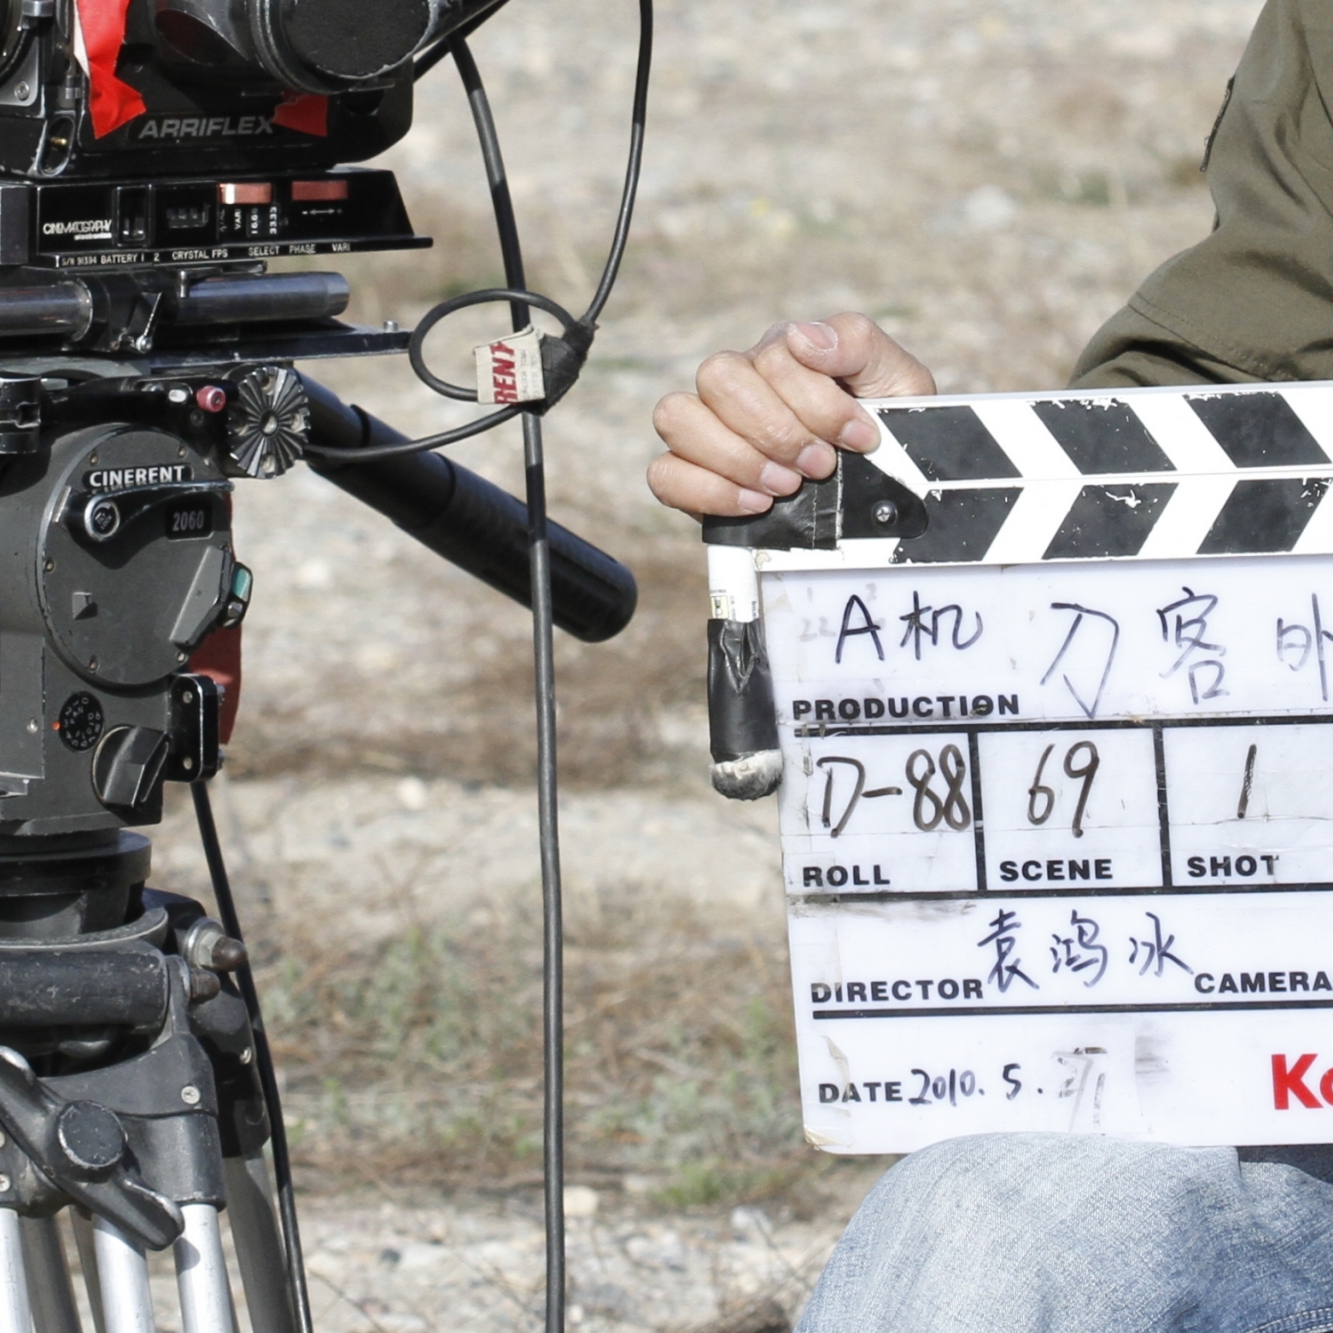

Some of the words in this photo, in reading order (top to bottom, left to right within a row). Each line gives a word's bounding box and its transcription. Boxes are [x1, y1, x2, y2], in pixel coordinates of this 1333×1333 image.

[139, 115, 274, 140] ARRIFLEX
[100, 254, 137, 265] BATTERY
[153, 252, 160, 262] 2
[172, 250, 209, 260] CRYSTAL
[212, 249, 228, 259] FPS
[248, 245, 280, 256] SELECT
[289, 244, 316, 254] PHASE
[332, 242, 351, 253] VARI
[89, 466, 185, 488] CINERENT
[172, 510, 204, 532] 2060
[793, 694, 1019, 720] PRODUCTION
[816, 743, 971, 838] D-88
[1027, 740, 1100, 838] 69
[1236, 743, 1257, 819] 1
[803, 865, 890, 887] ROLL
[1000, 859, 1113, 882] SCENE
[1187, 855, 1279, 878] SHOT
[811, 979, 983, 1003] DIRECTOR
[818, 1081, 903, 1103] DATE
